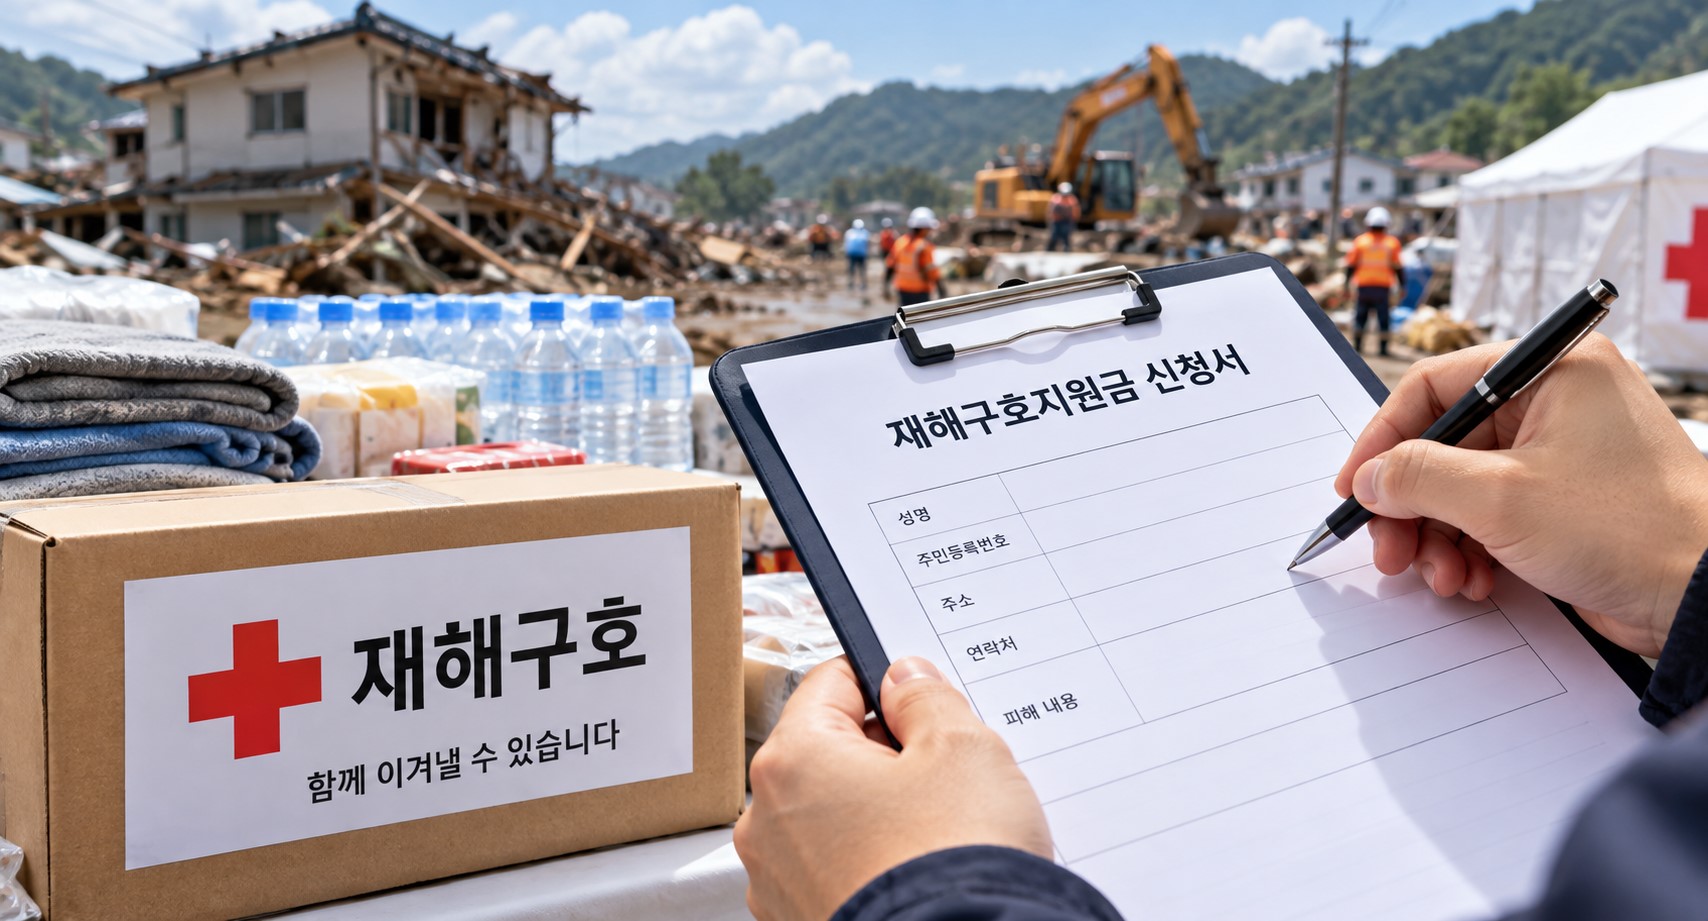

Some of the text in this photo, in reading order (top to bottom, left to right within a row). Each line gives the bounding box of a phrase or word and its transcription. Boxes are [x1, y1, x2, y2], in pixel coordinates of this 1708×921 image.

[885, 344, 1250, 449] 재해구호지원금 신청서
[898, 506, 931, 526] 성명
[916, 533, 1011, 568] 주민등록번호
[940, 593, 976, 613] 주소
[351, 596, 646, 711] 재해구호
[966, 635, 1018, 662] 연락처
[1002, 692, 1079, 725] 피해 내용
[306, 718, 621, 805] 함께 이겨낼 수 있습니다
